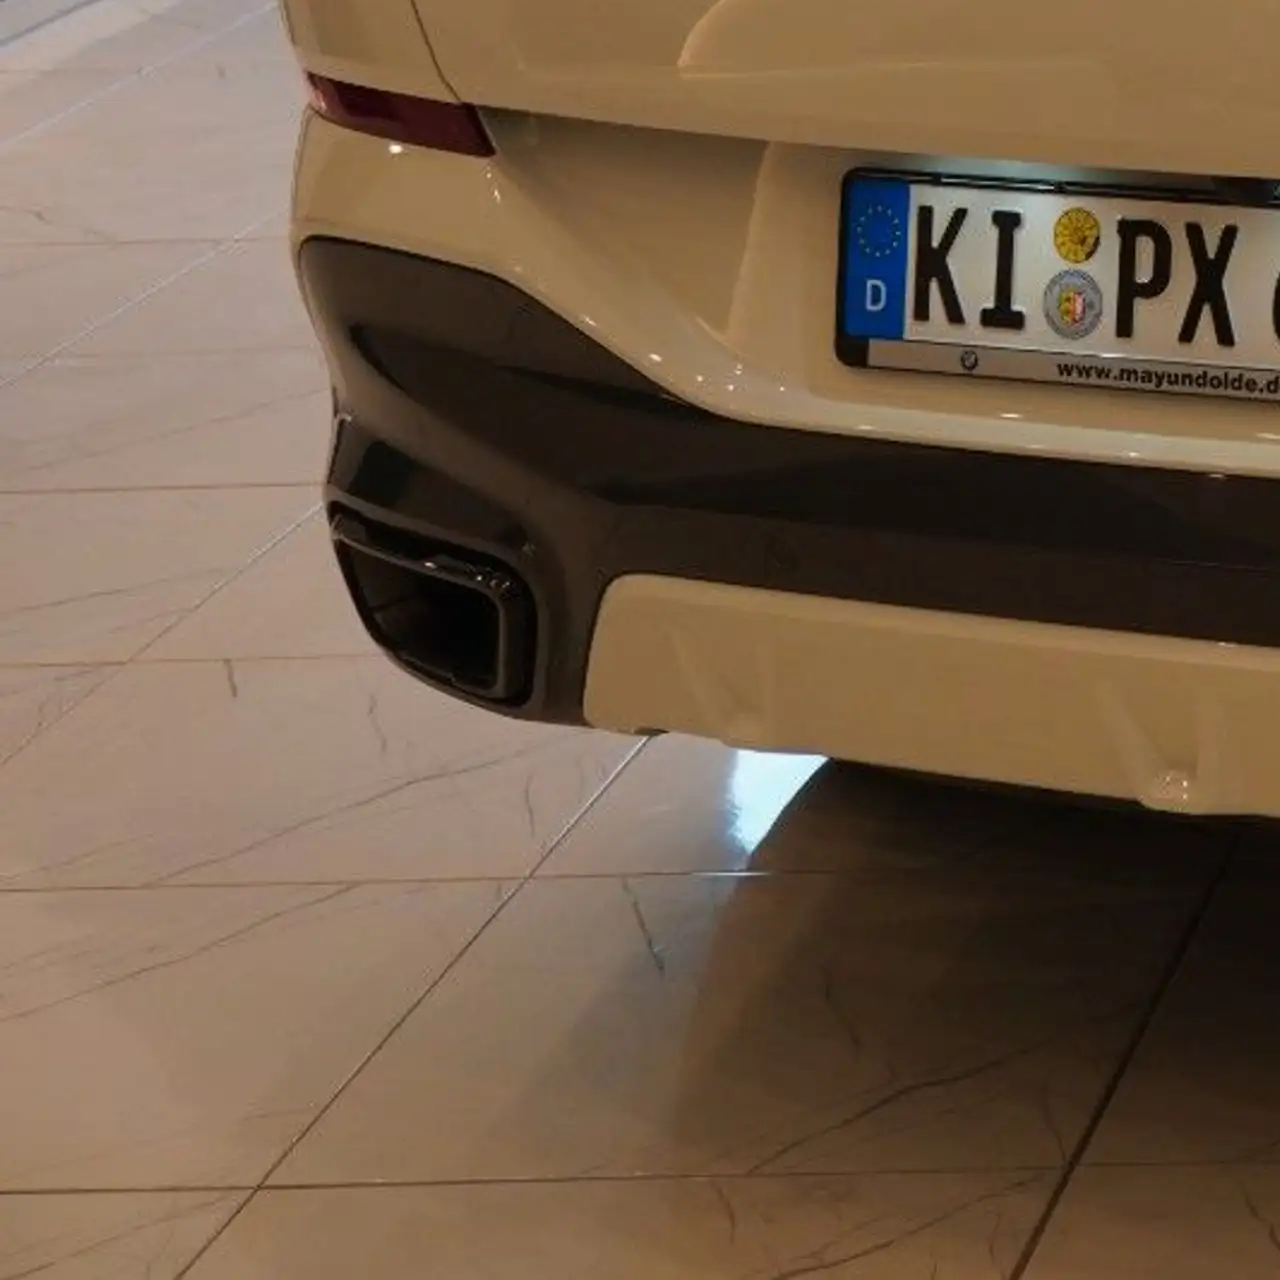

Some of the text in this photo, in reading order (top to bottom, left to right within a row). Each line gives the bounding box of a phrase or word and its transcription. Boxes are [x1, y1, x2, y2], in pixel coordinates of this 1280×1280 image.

[866, 279, 886, 311] D
[914, 206, 1024, 328] KI
[1115, 218, 1237, 346] PX
